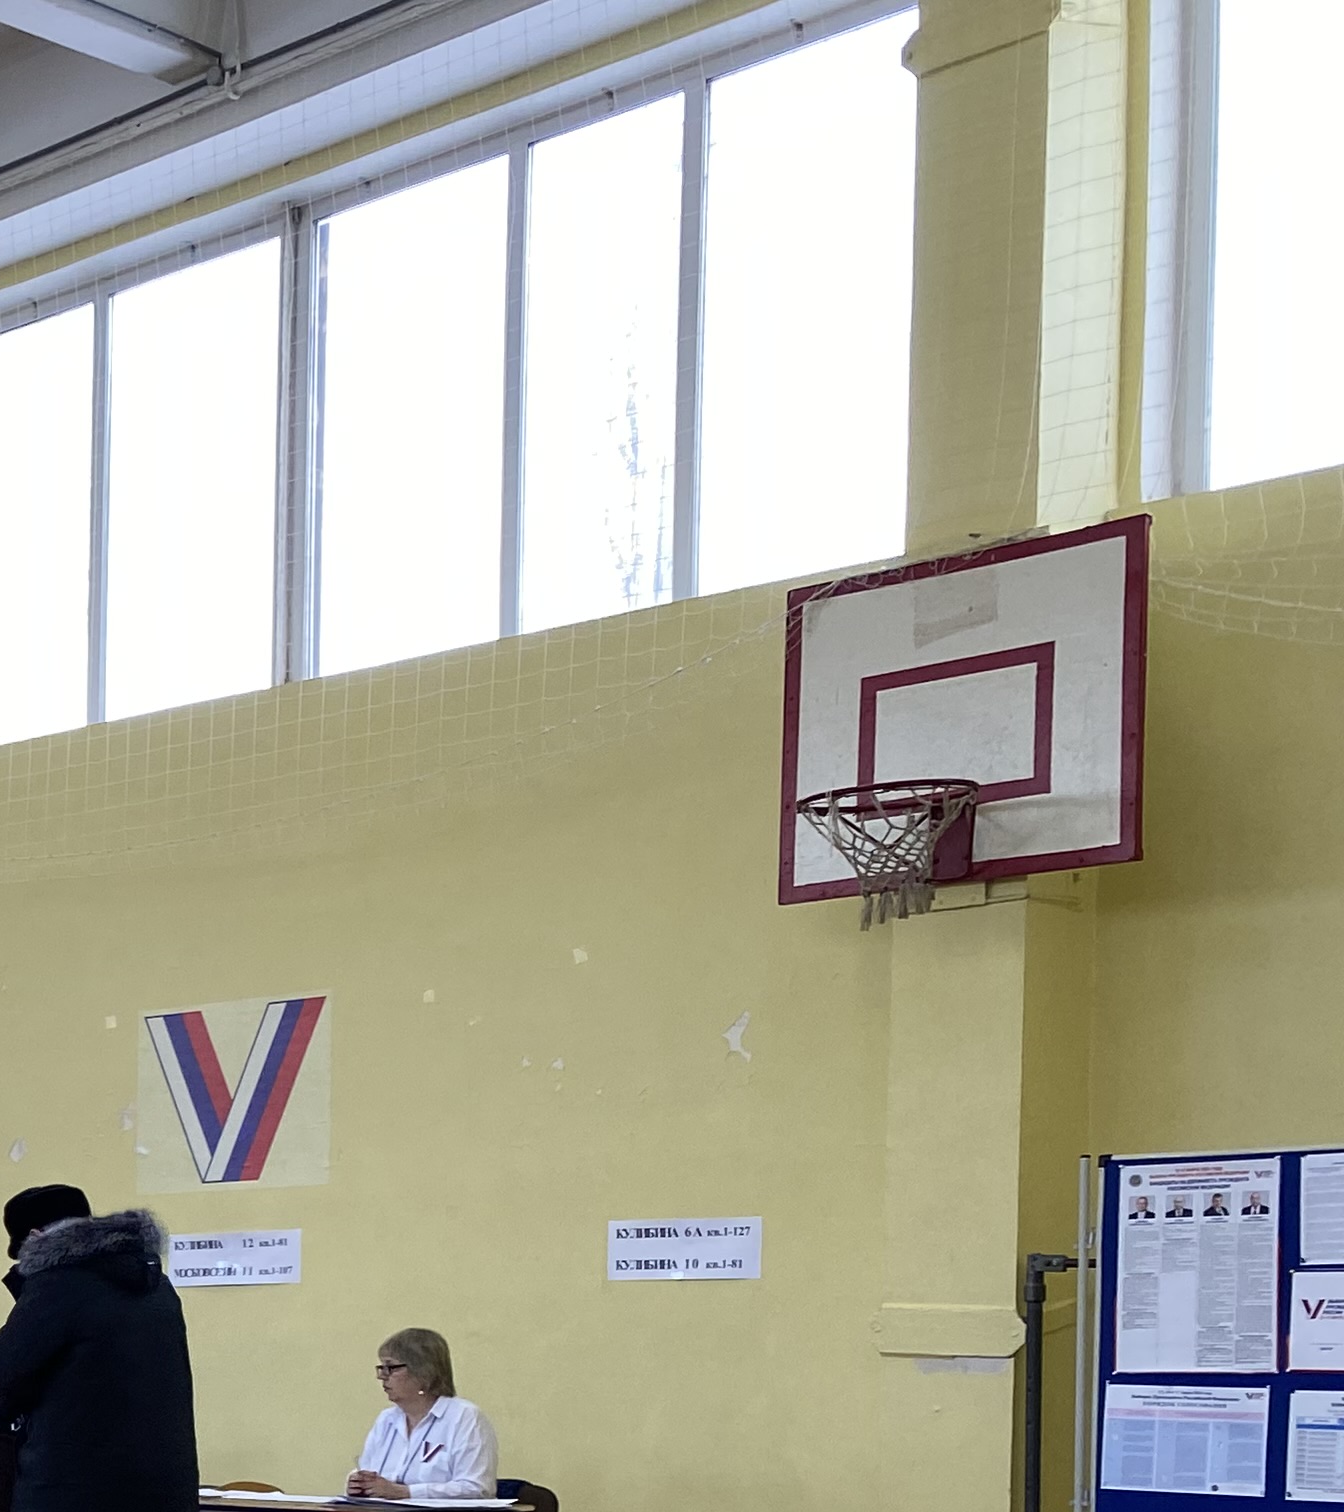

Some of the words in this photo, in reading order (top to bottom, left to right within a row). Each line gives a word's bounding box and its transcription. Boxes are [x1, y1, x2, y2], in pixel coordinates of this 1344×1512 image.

[616, 1227, 679, 1239] КУЛИБИНА
[174, 1239, 224, 1251] КУЛИБИНА
[242, 1238, 254, 1248] 12
[615, 1259, 678, 1270] КУЛИБИНА
[685, 1258, 699, 1269] 10
[242, 1266, 253, 1276] 11
